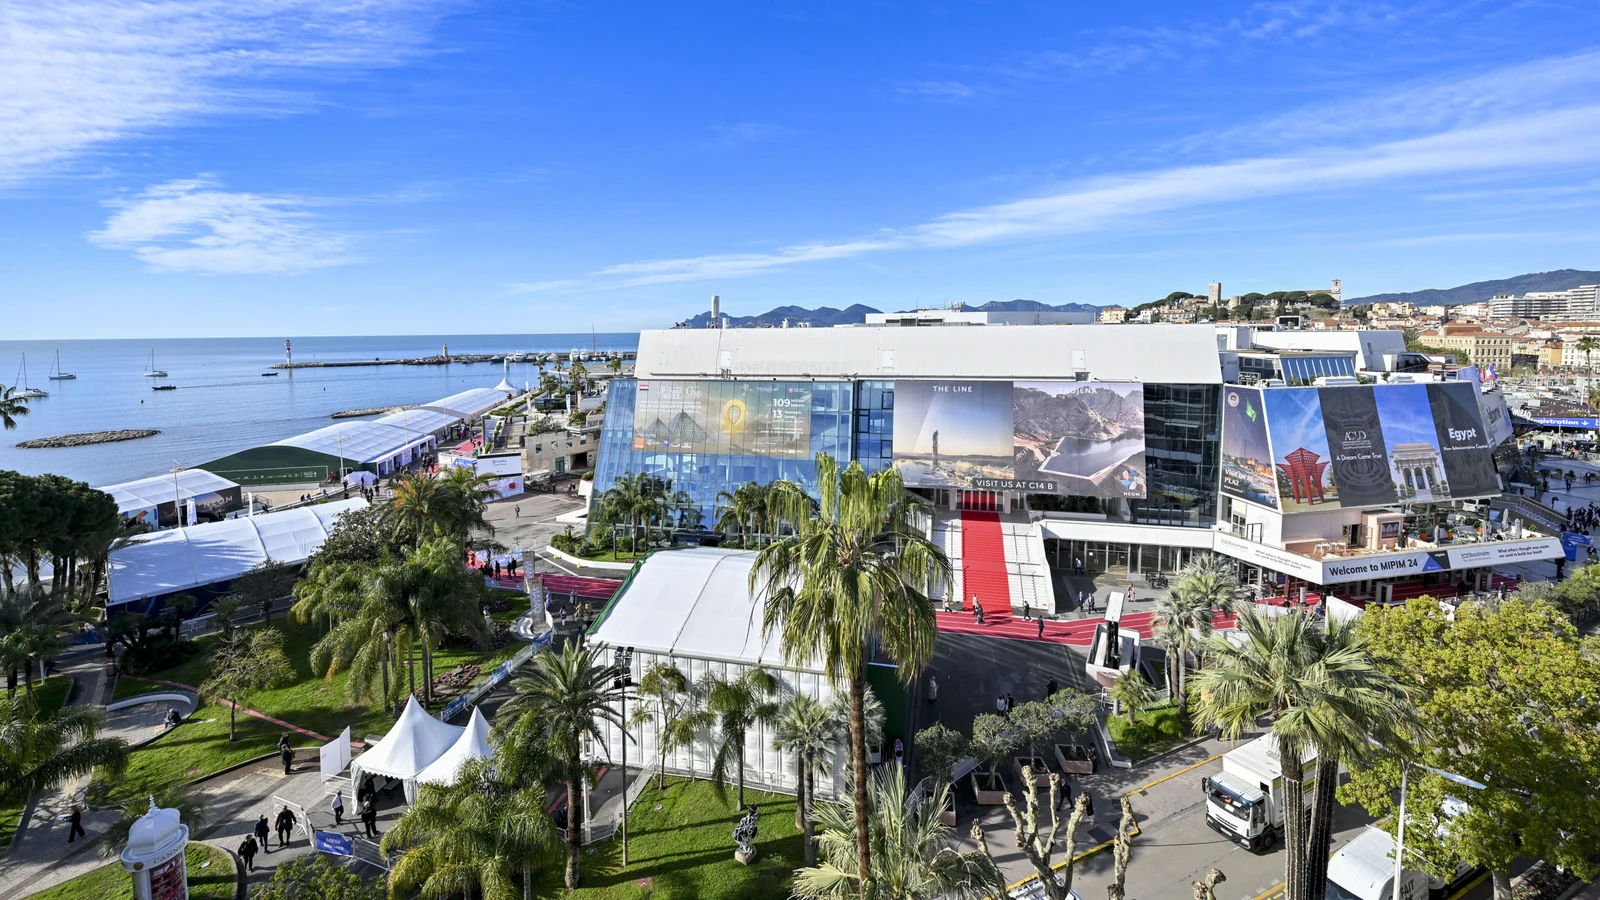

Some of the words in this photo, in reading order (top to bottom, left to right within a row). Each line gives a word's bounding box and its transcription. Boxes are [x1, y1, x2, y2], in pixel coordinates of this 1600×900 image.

[1058, 386, 1098, 395] TROJENA
[772, 398, 791, 407] 109
[772, 409, 783, 419] 13
[1532, 416, 1579, 426] egistration
[1448, 427, 1477, 441] Egypt
[976, 479, 999, 488] VISIT
[1001, 480, 1014, 488] US
[1016, 480, 1028, 489] AT
[1028, 481, 1045, 490] C14
[1047, 481, 1054, 490] B
[1328, 565, 1368, 577] Welcome
[1369, 563, 1379, 572] to
[1380, 560, 1406, 570] MIPIM
[1408, 558, 1418, 568] 24
[153, 841, 186, 864] CANNES
